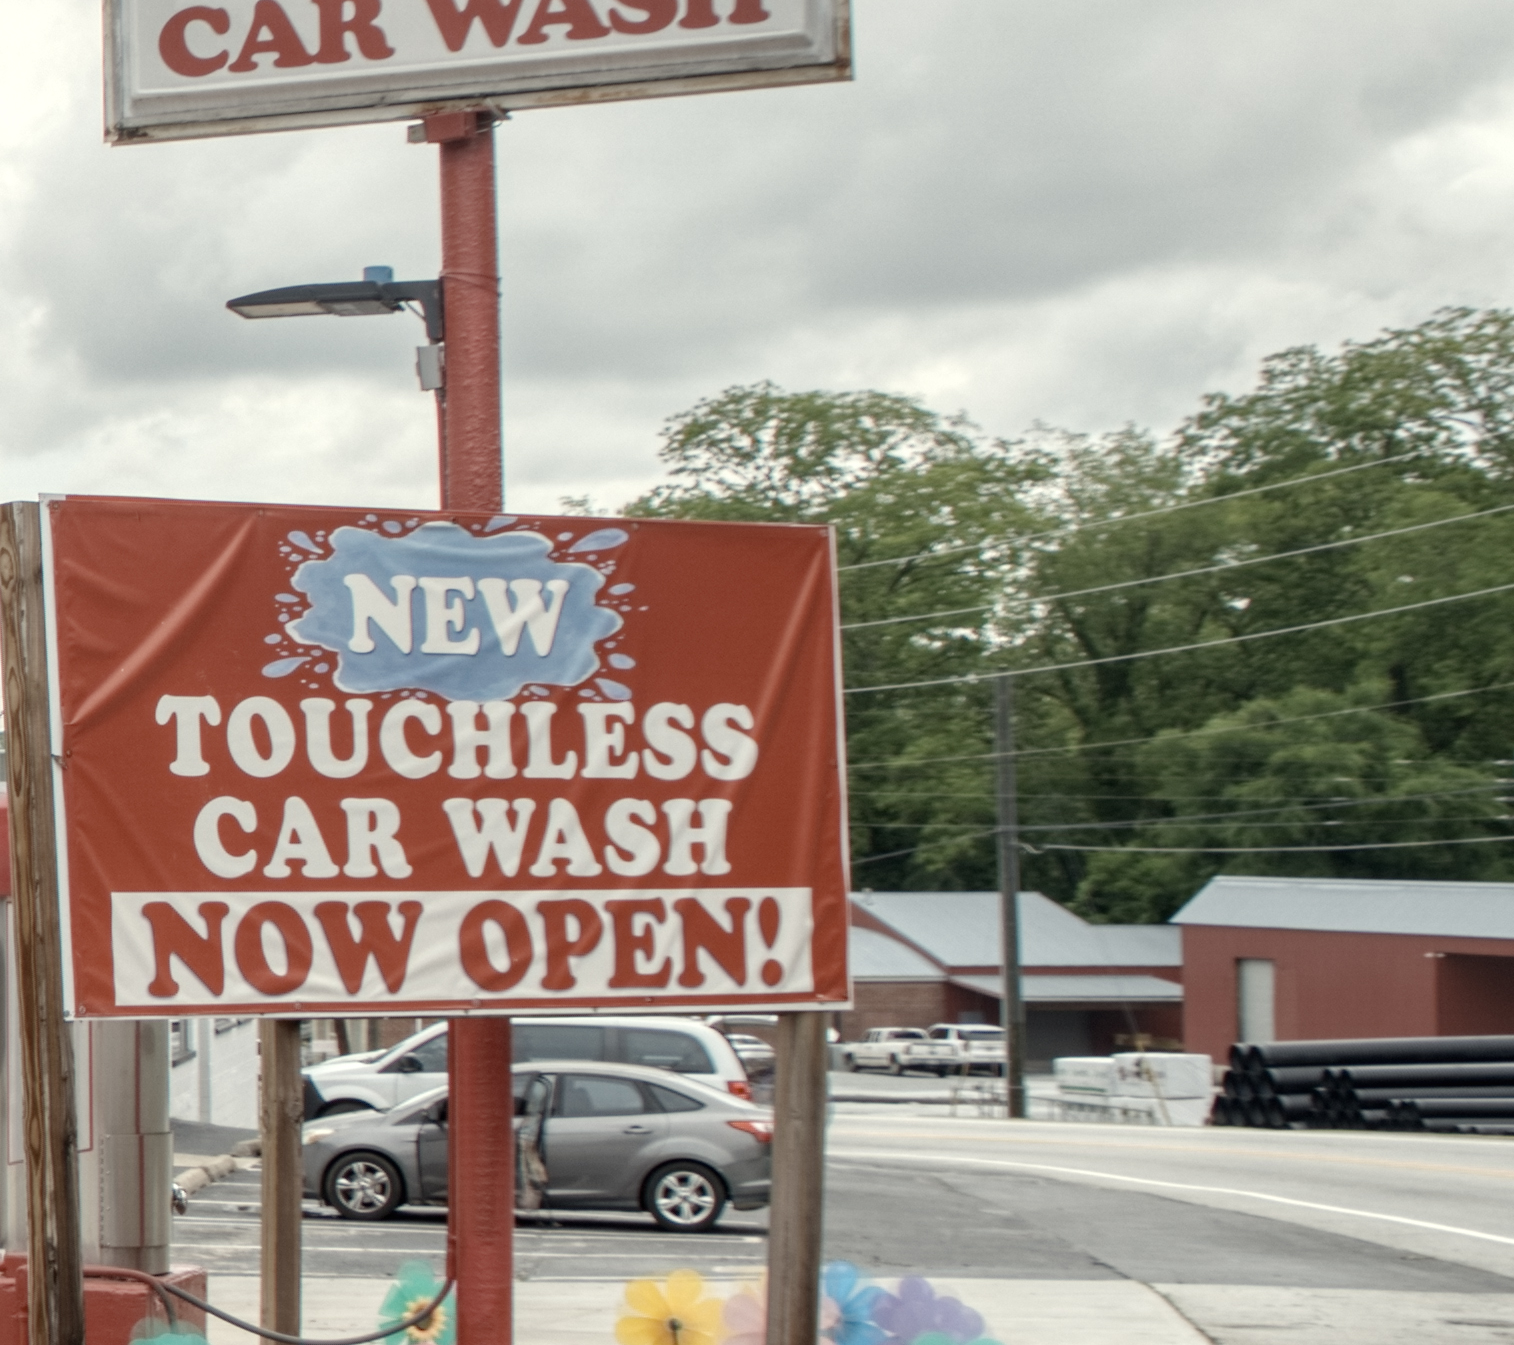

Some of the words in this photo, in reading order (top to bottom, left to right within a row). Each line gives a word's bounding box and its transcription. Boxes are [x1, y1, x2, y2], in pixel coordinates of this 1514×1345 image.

[343, 573, 570, 657] NEW
[155, 694, 760, 782] TOUCHLESS
[193, 795, 413, 880] CAR
[442, 796, 733, 880] WASH
[141, 899, 424, 997] NOW
[458, 896, 785, 992] OPEN!
